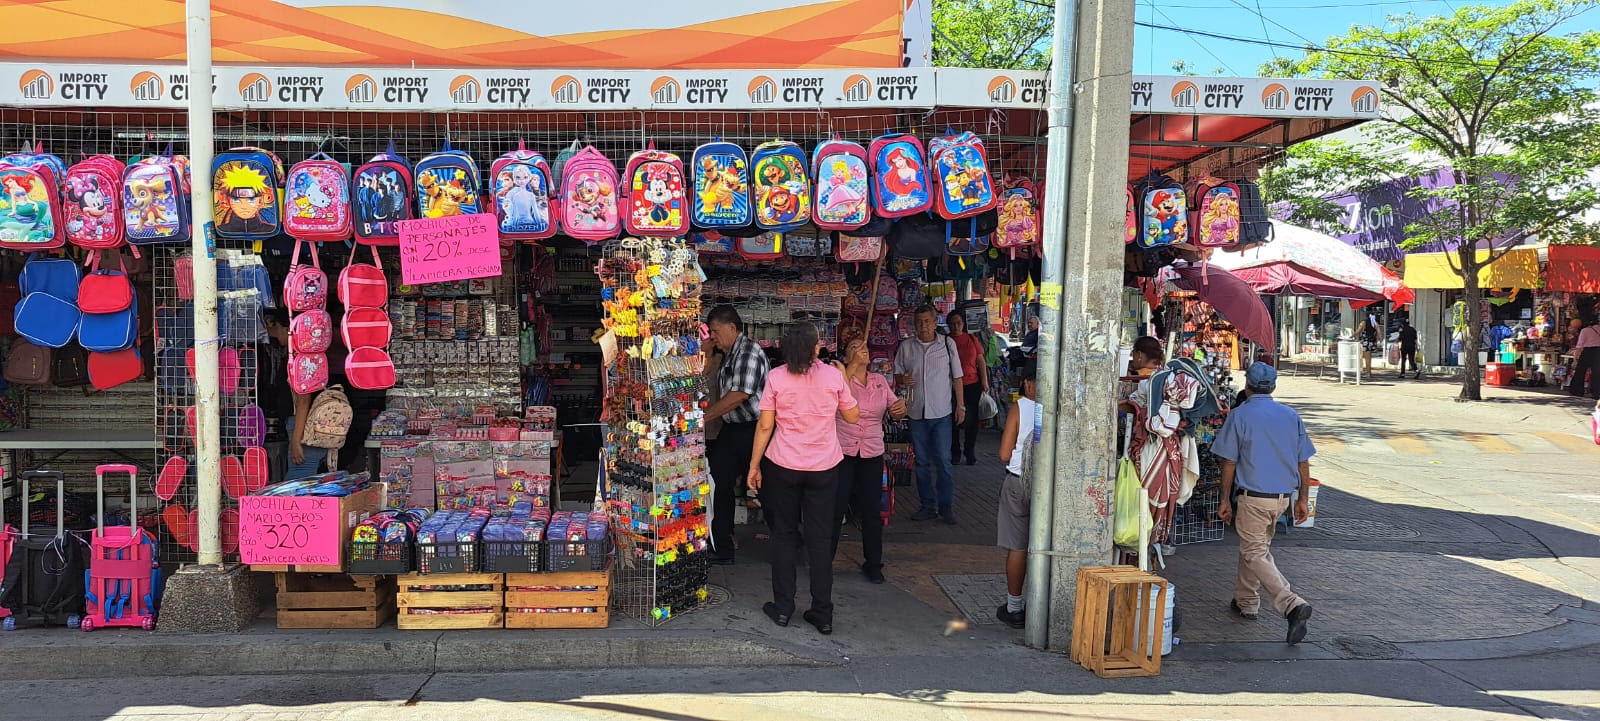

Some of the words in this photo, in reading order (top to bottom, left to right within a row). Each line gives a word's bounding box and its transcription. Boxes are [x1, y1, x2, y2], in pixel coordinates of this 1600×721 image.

[60, 73, 108, 83] IMPORT
[278, 76, 324, 87] IMPORT
[383, 77, 429, 87] IMPORT
[487, 78, 532, 88] IMPORT
[588, 78, 630, 88] IMPORT
[686, 79, 728, 88] IMPORT
[783, 77, 824, 87] IMPORT
[877, 76, 918, 86] IMPORT
[61, 84, 108, 100] CITY
[279, 86, 324, 103] CITY
[384, 87, 429, 103] CITY
[488, 87, 532, 104] CITY
[588, 87, 631, 104] CITY
[687, 88, 729, 104] CITY
[783, 87, 824, 104] CITY
[878, 86, 918, 101] CITY
[1205, 84, 1244, 94] IMPORT
[1295, 86, 1334, 97] IMPORT
[1205, 93, 1244, 109] CITY
[1295, 95, 1333, 112] CITY
[405, 225, 487, 245] PERSONAJES
[423, 239, 462, 262] 20%
[241, 497, 300, 511] MOCHILA
[311, 498, 327, 510] DE
[246, 512, 283, 525] MARIO
[287, 512, 324, 524] BROS
